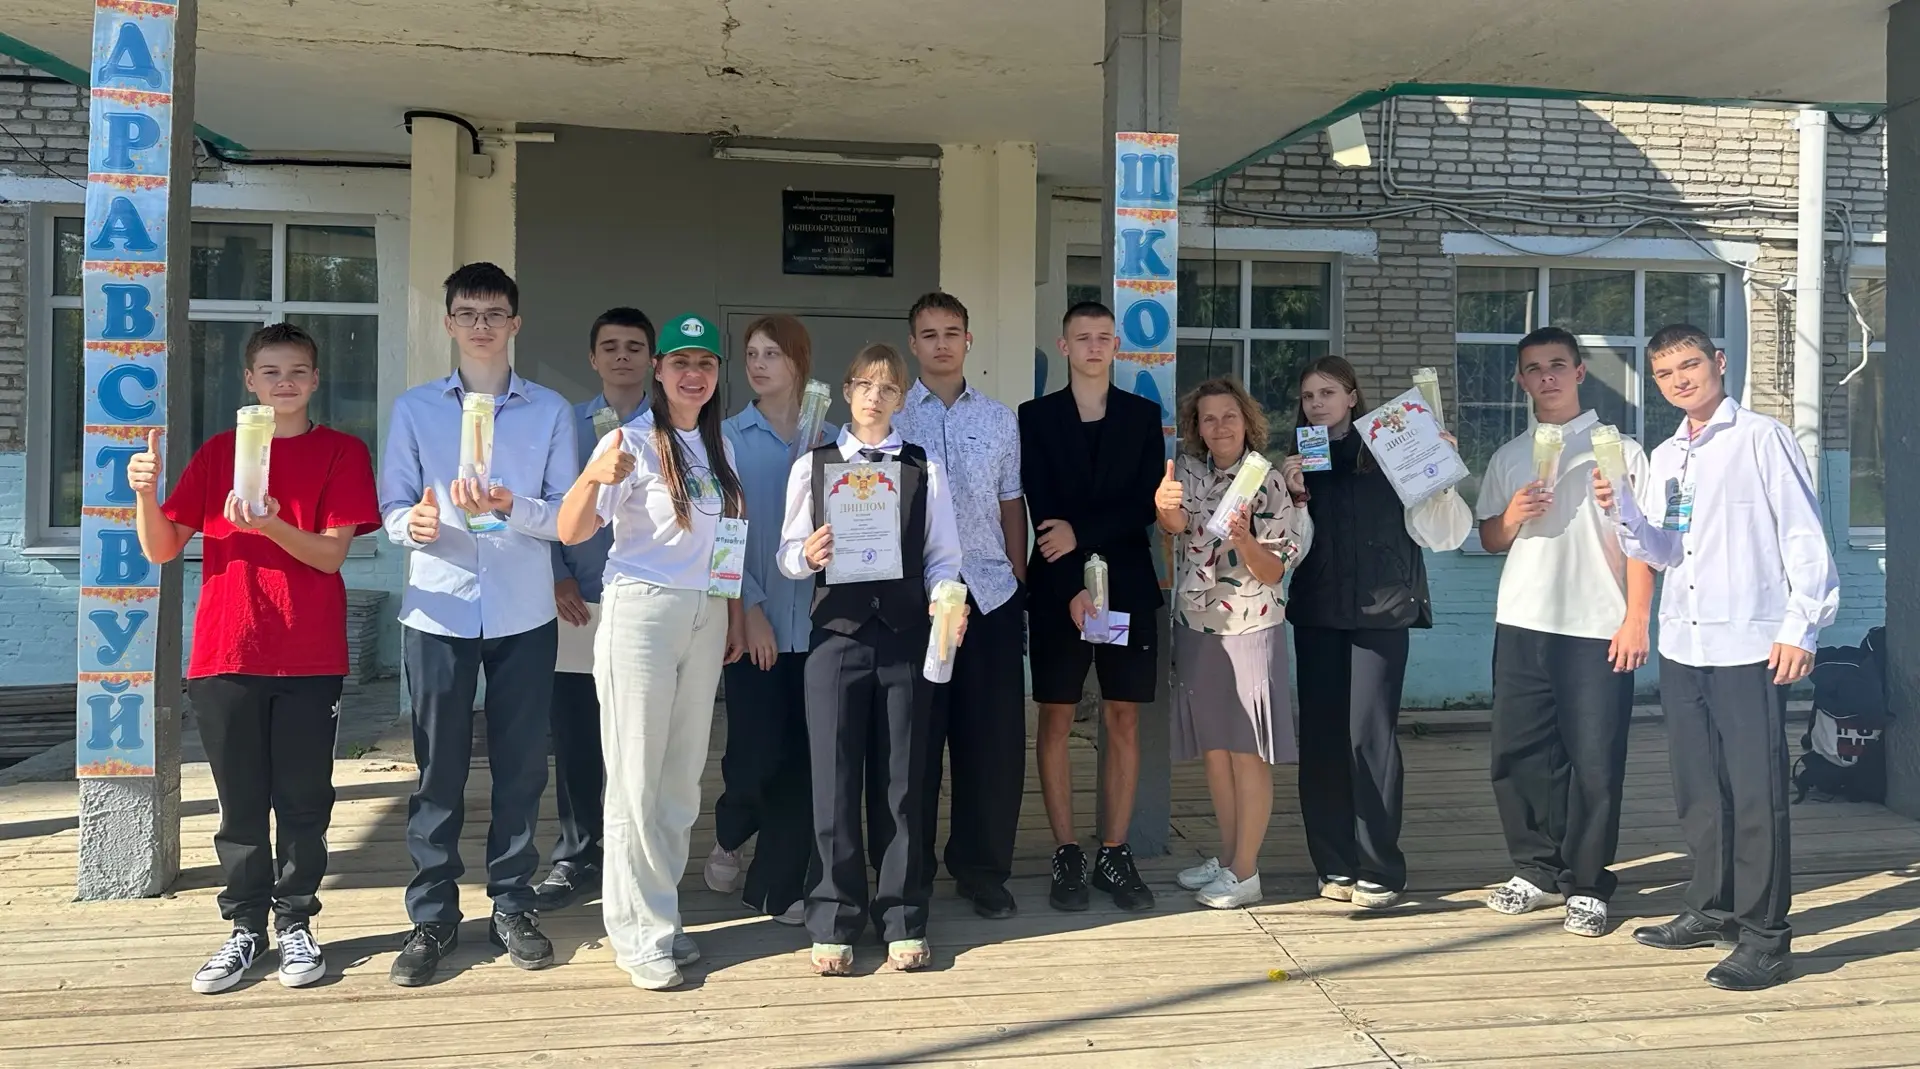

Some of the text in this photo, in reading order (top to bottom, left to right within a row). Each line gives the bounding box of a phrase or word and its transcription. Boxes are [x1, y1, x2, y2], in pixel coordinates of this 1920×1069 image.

[788, 223, 888, 235] ОБЩЕОБРАЗОВАТЕЛЬНАЯ
[824, 235, 854, 244] ШКОЛА
[1385, 427, 1420, 452] ДИПЛО
[840, 501, 886, 514] ДИПЛОМ
